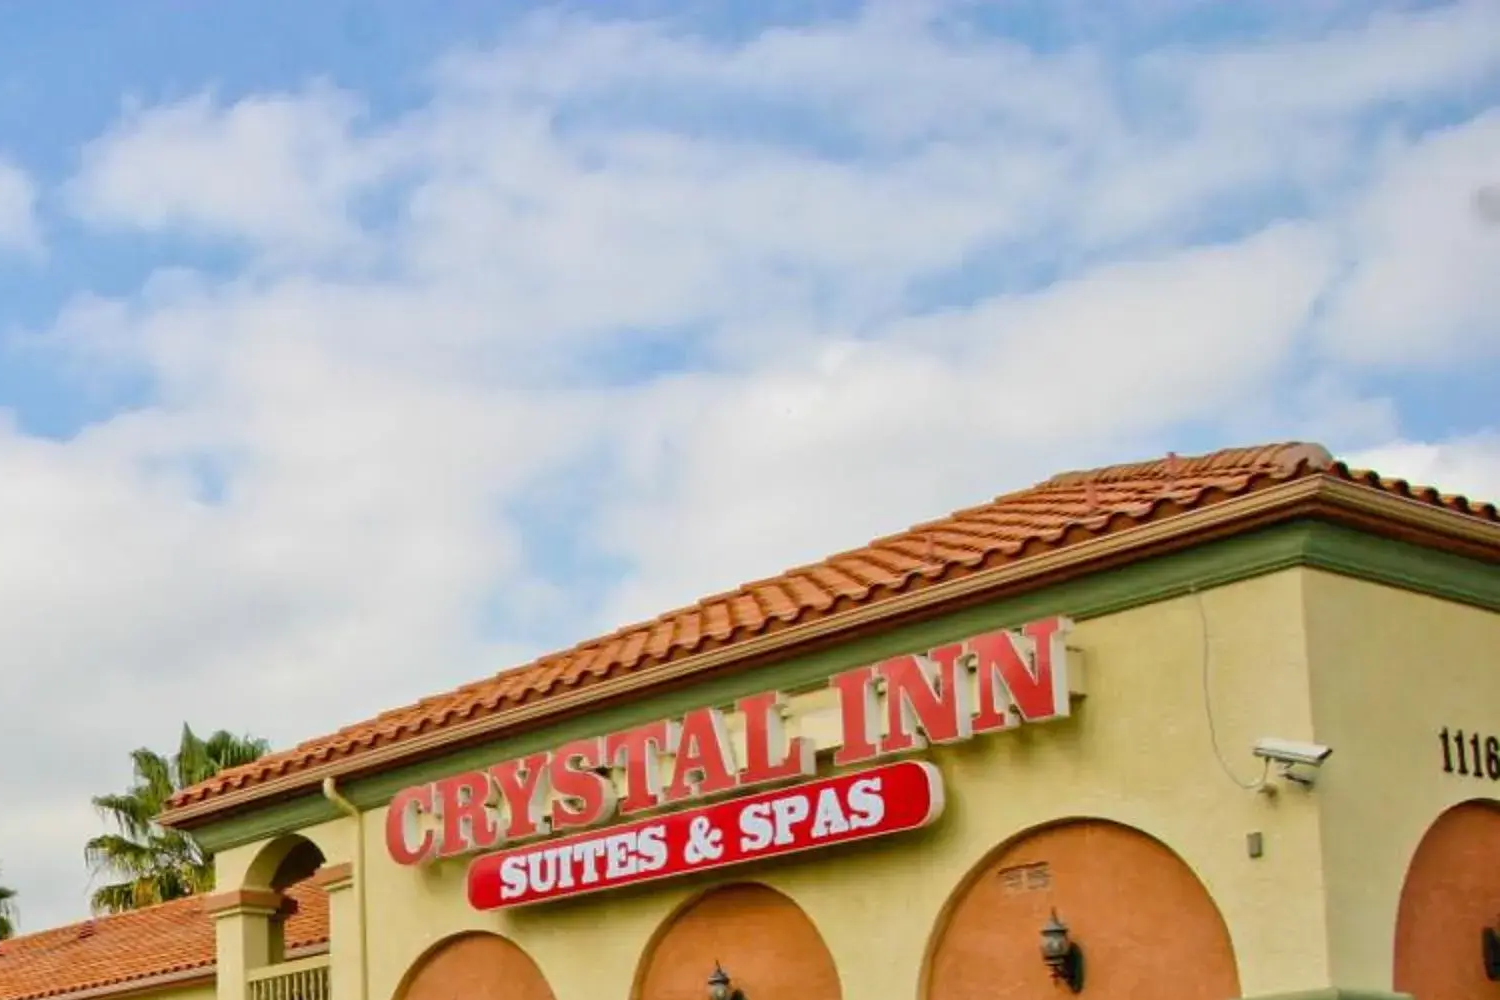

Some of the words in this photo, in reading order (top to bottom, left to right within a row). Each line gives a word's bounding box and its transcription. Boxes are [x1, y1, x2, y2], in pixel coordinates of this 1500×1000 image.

[386, 690, 806, 866] CRYSTAL
[829, 616, 1066, 766] INN
[1438, 725, 1500, 781] 1116
[501, 825, 668, 900] SUITES
[684, 815, 724, 864] &
[739, 776, 885, 852] SPAS
